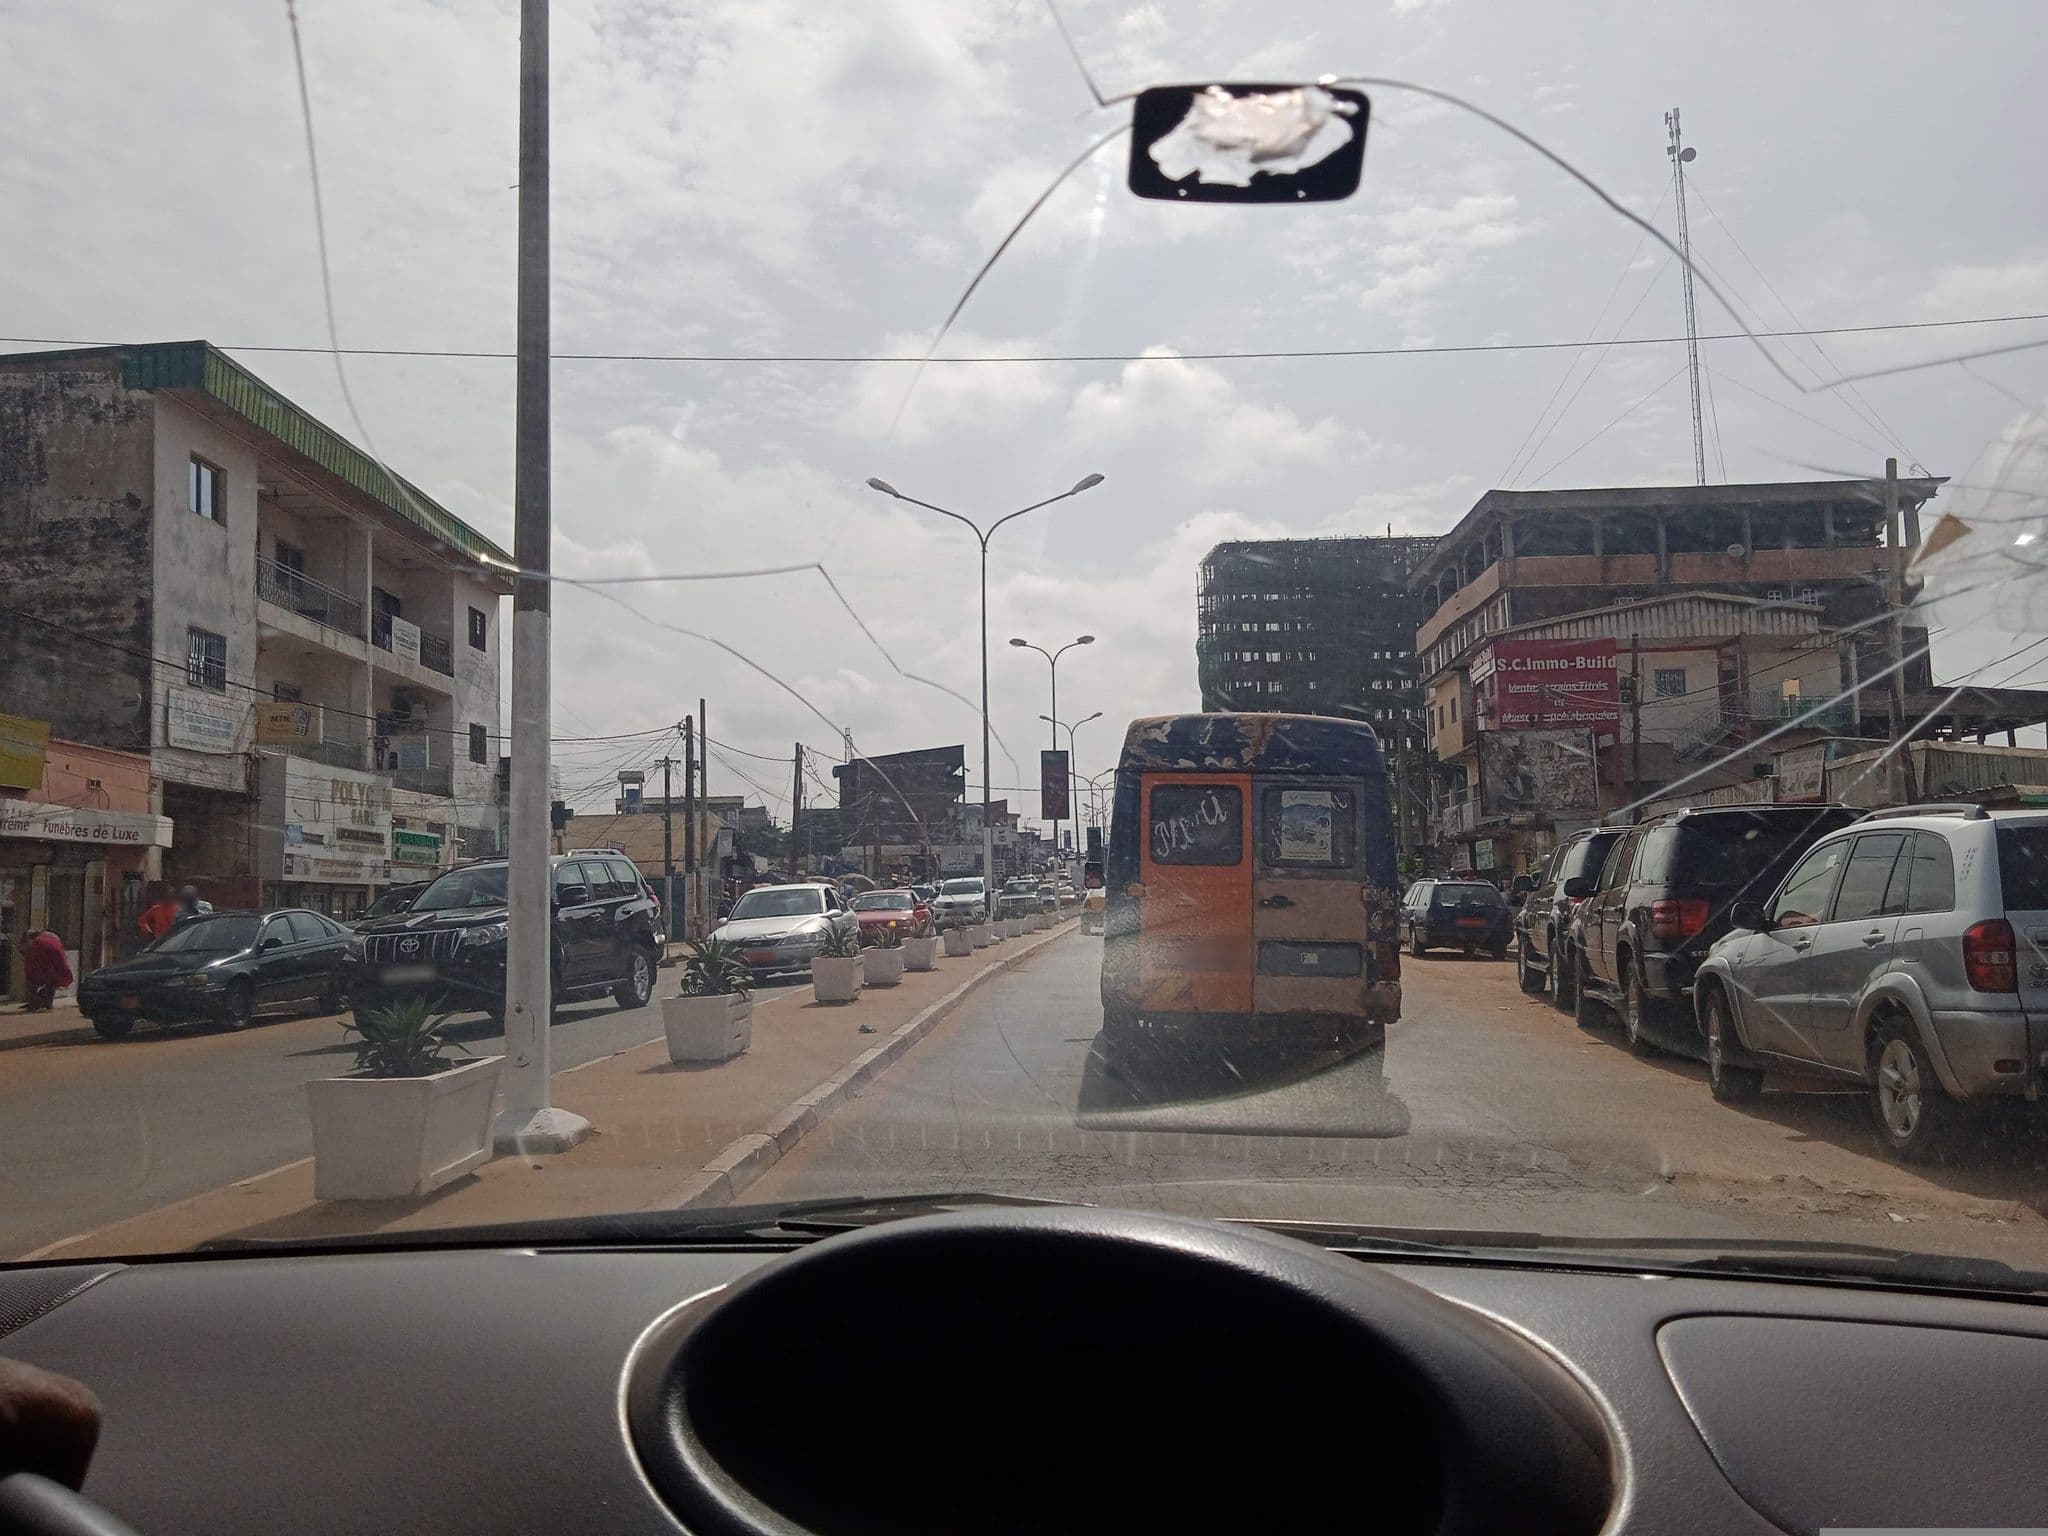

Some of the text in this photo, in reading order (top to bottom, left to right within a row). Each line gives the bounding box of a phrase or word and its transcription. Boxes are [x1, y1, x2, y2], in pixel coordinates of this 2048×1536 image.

[1496, 656, 1617, 672] S.C.Immo-Build
[270, 714, 290, 723] MTN
[43, 818, 89, 838] Funèbres
[92, 824, 109, 839] de
[113, 826, 140, 841] Luxe
